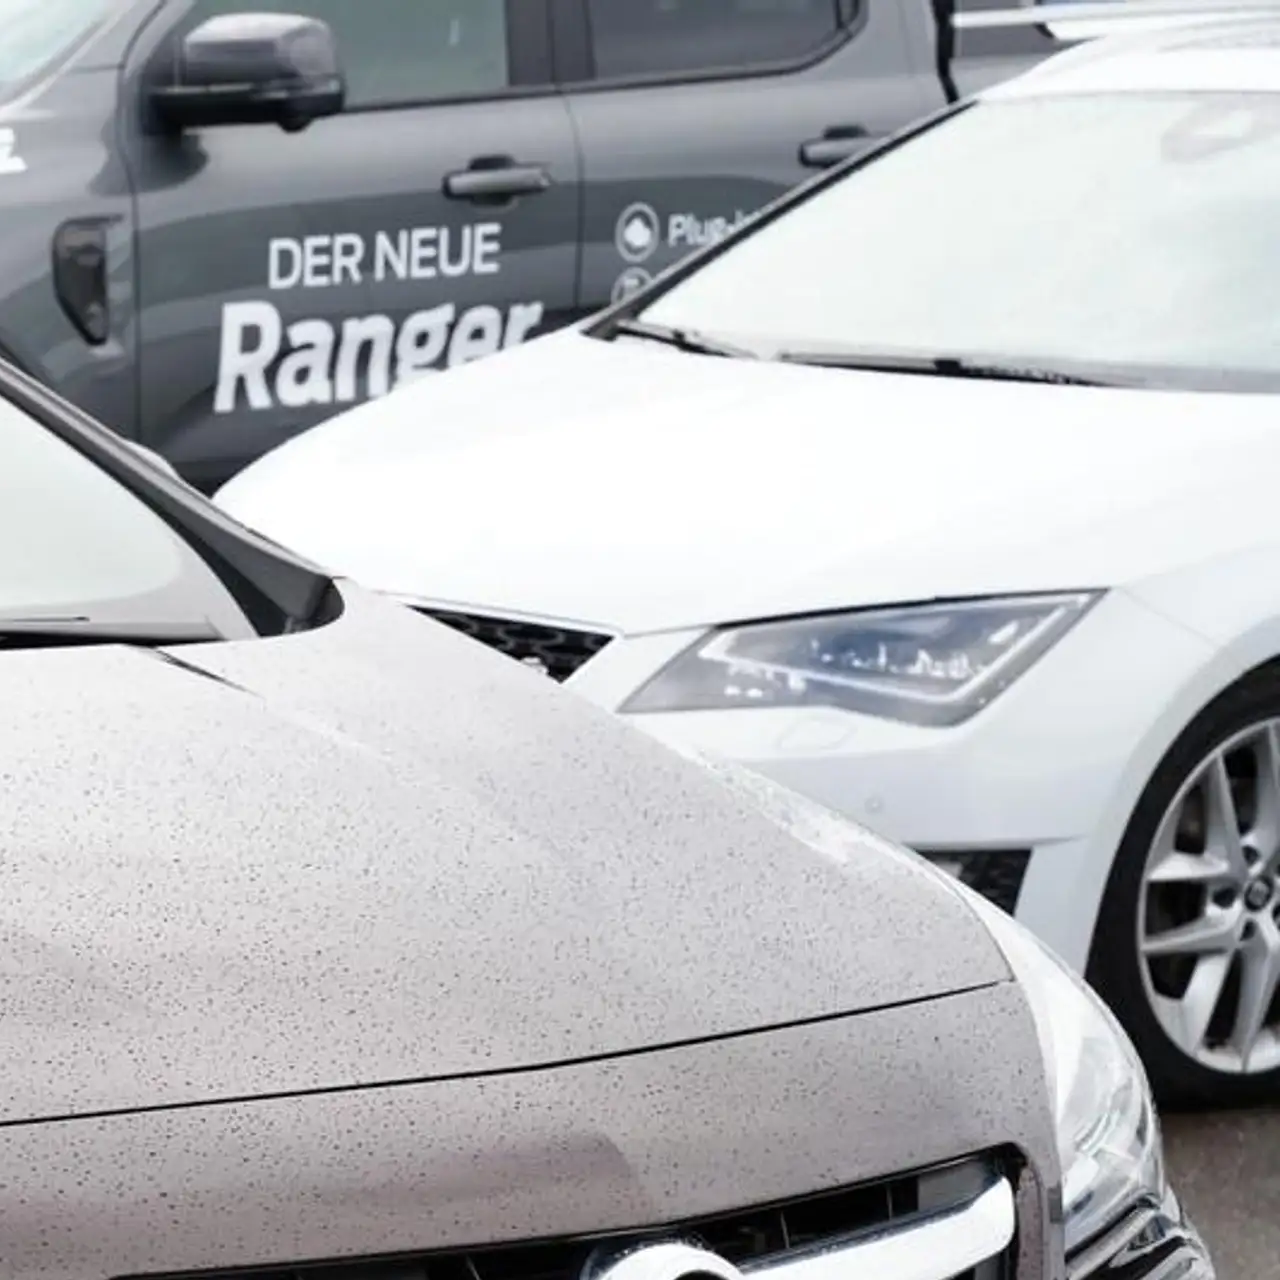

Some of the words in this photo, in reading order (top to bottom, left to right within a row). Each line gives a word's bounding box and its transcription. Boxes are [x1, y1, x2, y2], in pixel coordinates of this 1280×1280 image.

[268, 233, 365, 289] DER
[374, 223, 502, 281] NEUE
[214, 300, 545, 413] Ranger
